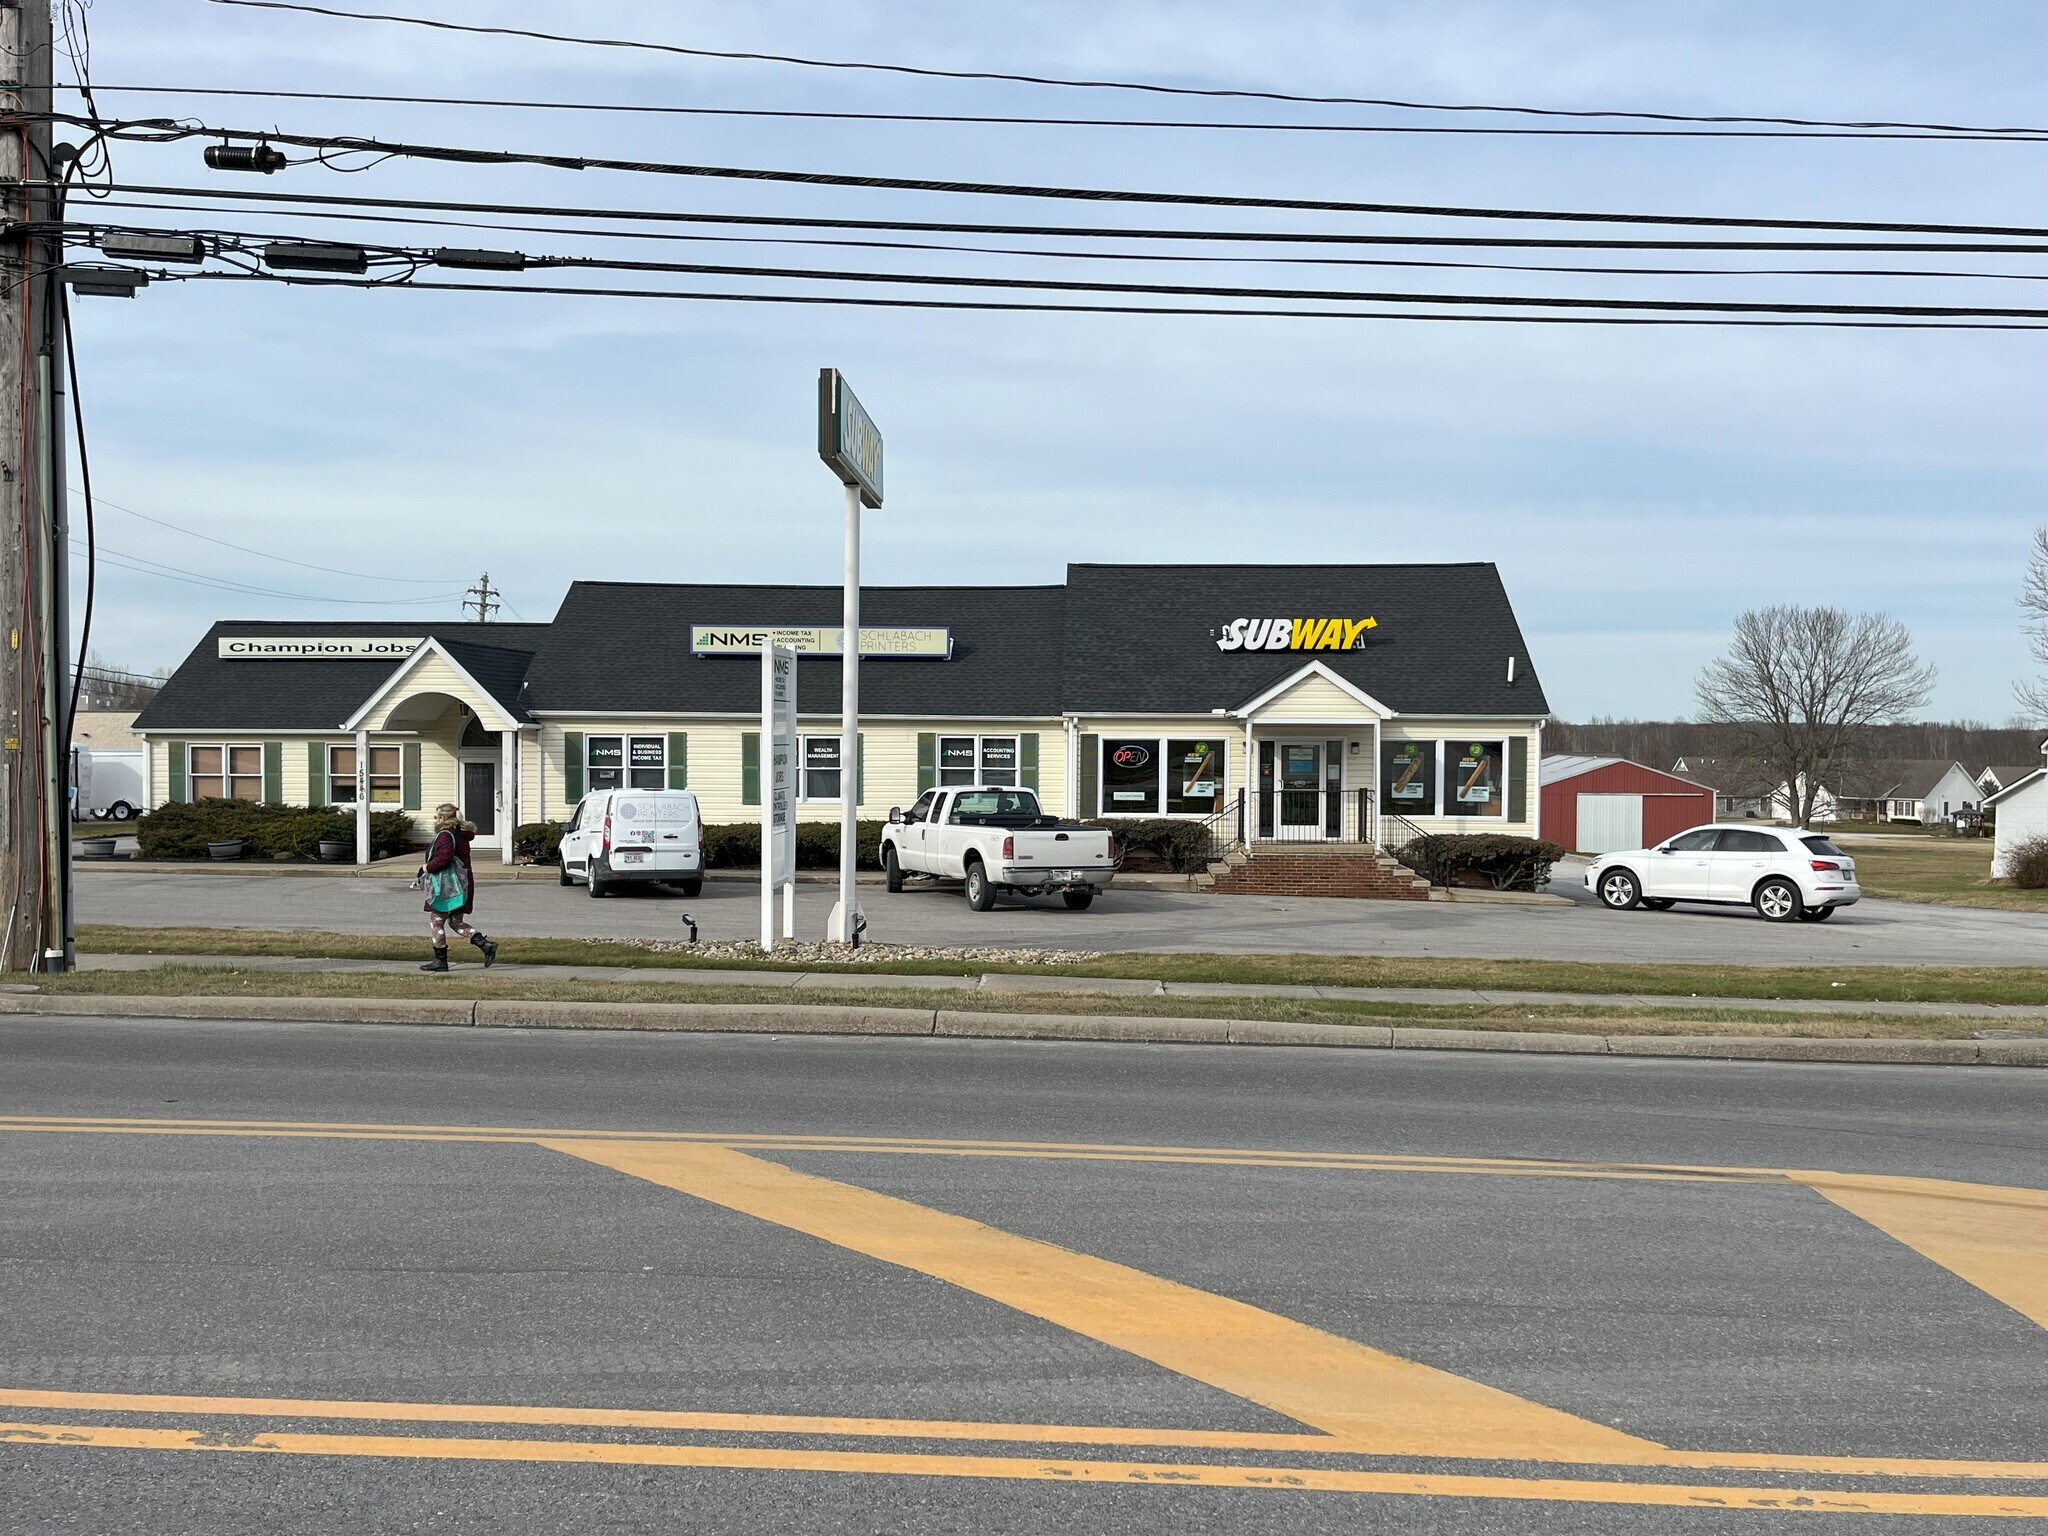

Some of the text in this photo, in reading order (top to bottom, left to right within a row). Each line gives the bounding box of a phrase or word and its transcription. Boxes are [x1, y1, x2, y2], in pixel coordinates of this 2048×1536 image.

[843, 400, 880, 486] SUBWAY
[710, 633, 768, 646] NMS
[860, 629, 932, 641] SCHLABACH
[1216, 616, 1378, 651] SUBWAY
[229, 642, 416, 655] Champion Jobs
[860, 641, 917, 652] PRINTERS
[1116, 751, 1146, 762] OPEN
[637, 802, 690, 811] SCHLABACH
[637, 811, 680, 819] PRINTERS
